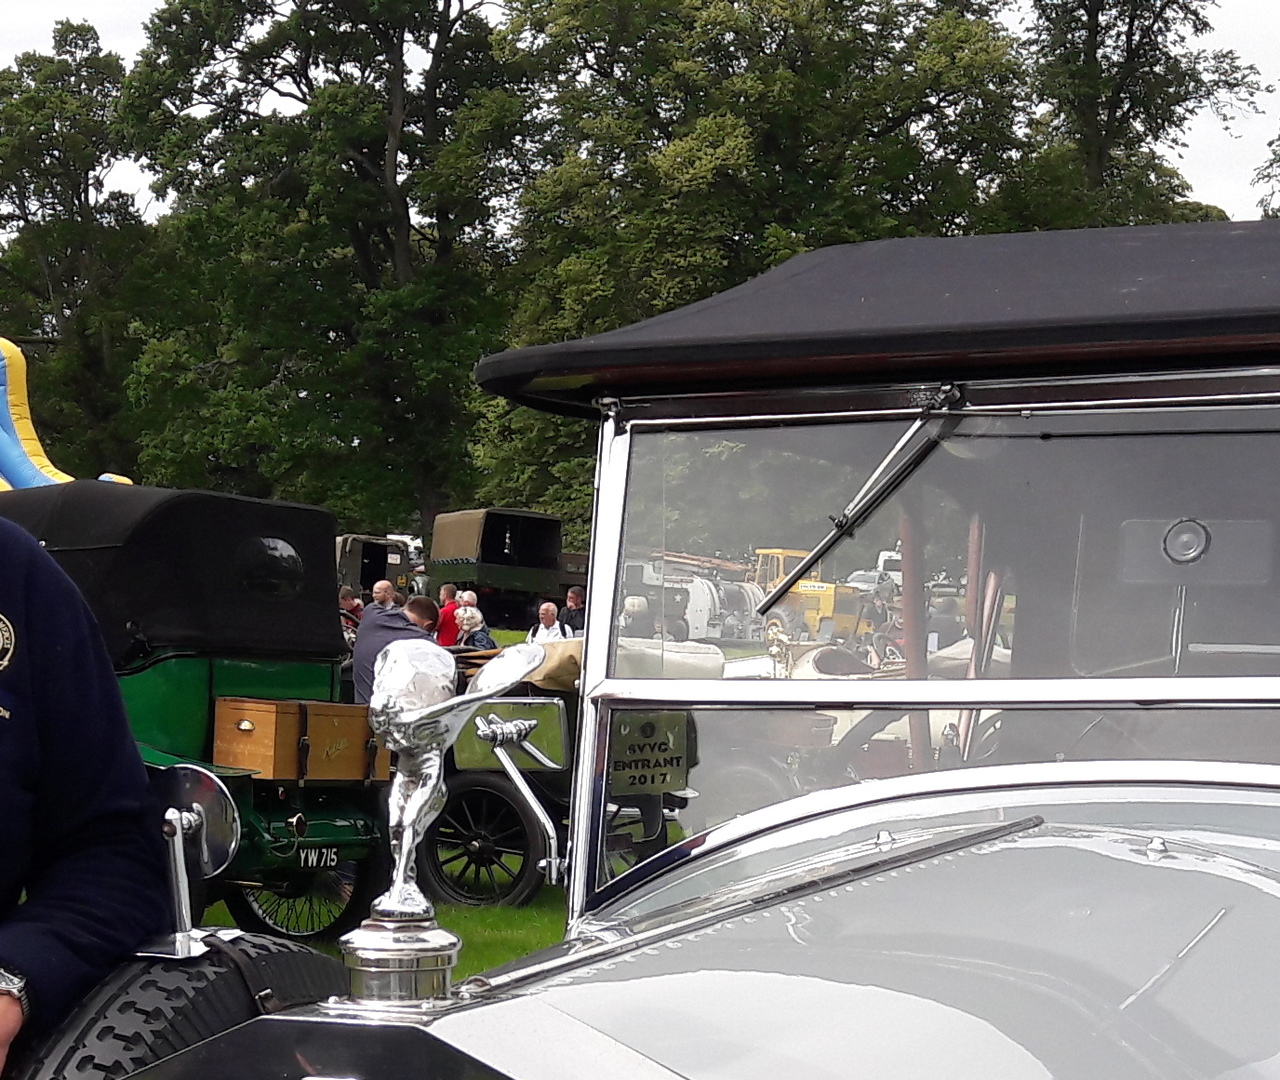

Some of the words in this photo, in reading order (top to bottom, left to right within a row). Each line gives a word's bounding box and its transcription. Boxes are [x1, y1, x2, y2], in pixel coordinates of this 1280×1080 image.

[613, 756, 683, 771] ENTRANT
[629, 773, 668, 786] 2017
[299, 849, 320, 867] YW
[320, 848, 338, 867] 715
